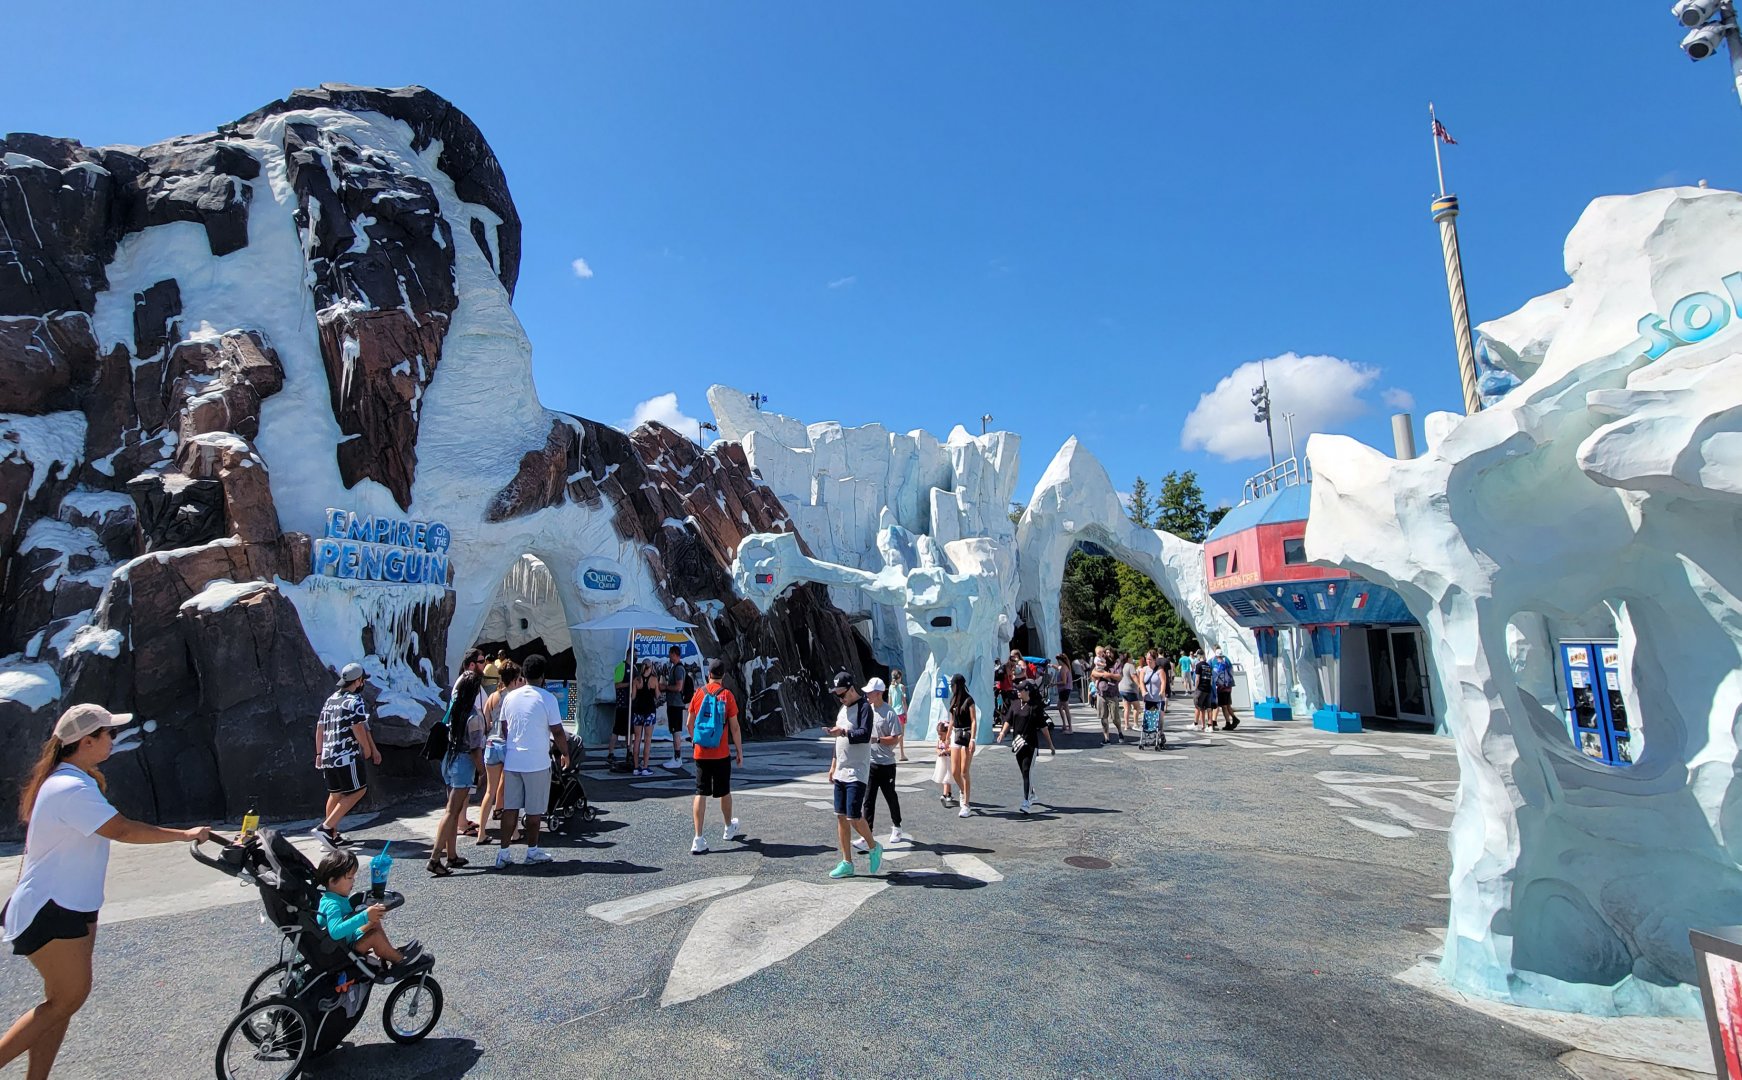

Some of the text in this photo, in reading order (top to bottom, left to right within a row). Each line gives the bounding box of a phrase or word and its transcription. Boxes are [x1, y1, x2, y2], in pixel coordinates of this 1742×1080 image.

[436, 526, 447, 536] OF
[433, 536, 447, 546] THE
[314, 538, 449, 585] PENGUIN
[634, 633, 666, 643] Penguin
[634, 643, 688, 656] EXHIT
